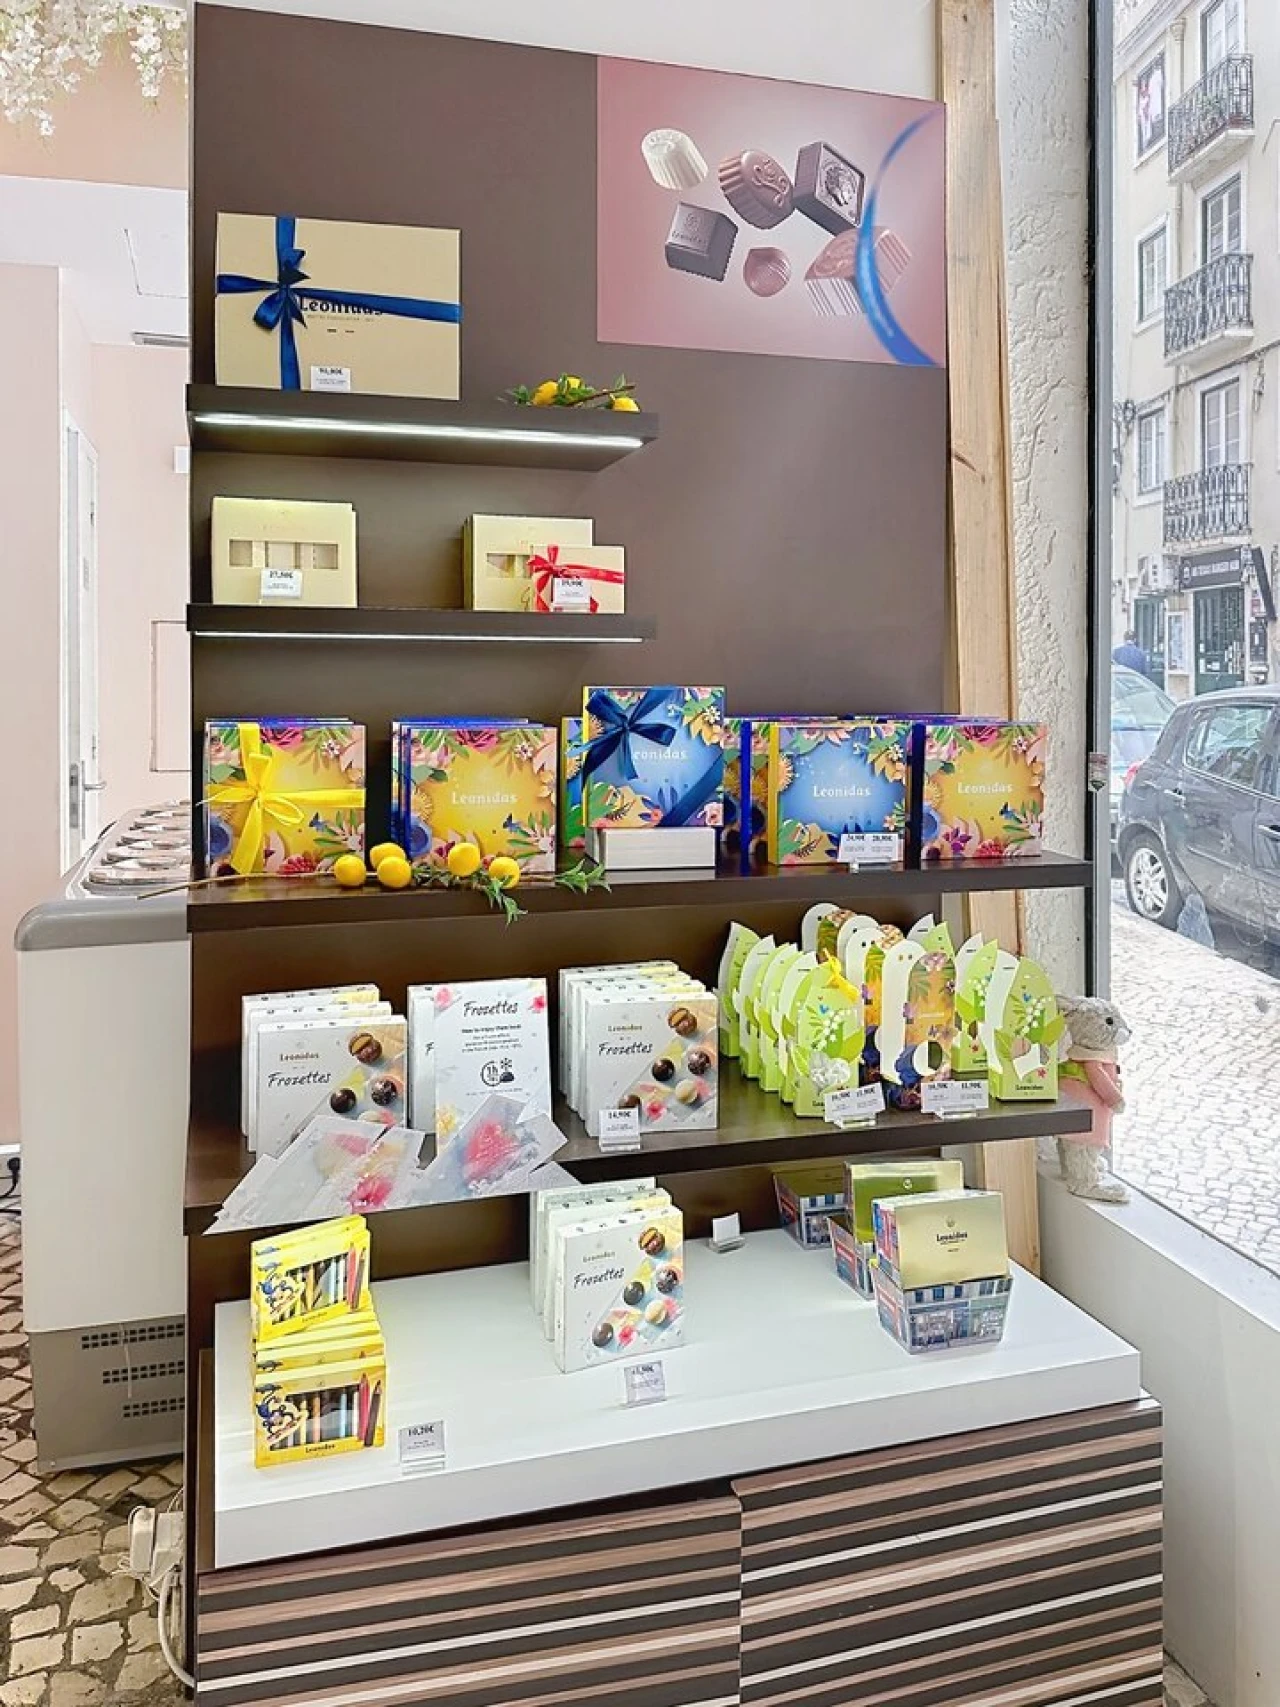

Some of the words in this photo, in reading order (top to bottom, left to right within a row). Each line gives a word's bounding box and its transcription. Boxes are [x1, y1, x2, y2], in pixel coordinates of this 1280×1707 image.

[632, 746, 688, 760] eonidas
[813, 785, 872, 798] Leonidas
[957, 782, 1013, 794] Leonidas
[452, 790, 518, 804] Leonidas
[463, 1000, 519, 1017] Frozettes
[598, 1041, 653, 1057] Frozettes
[267, 1071, 332, 1088] Frozettes
[573, 1268, 625, 1289] Frozettes
